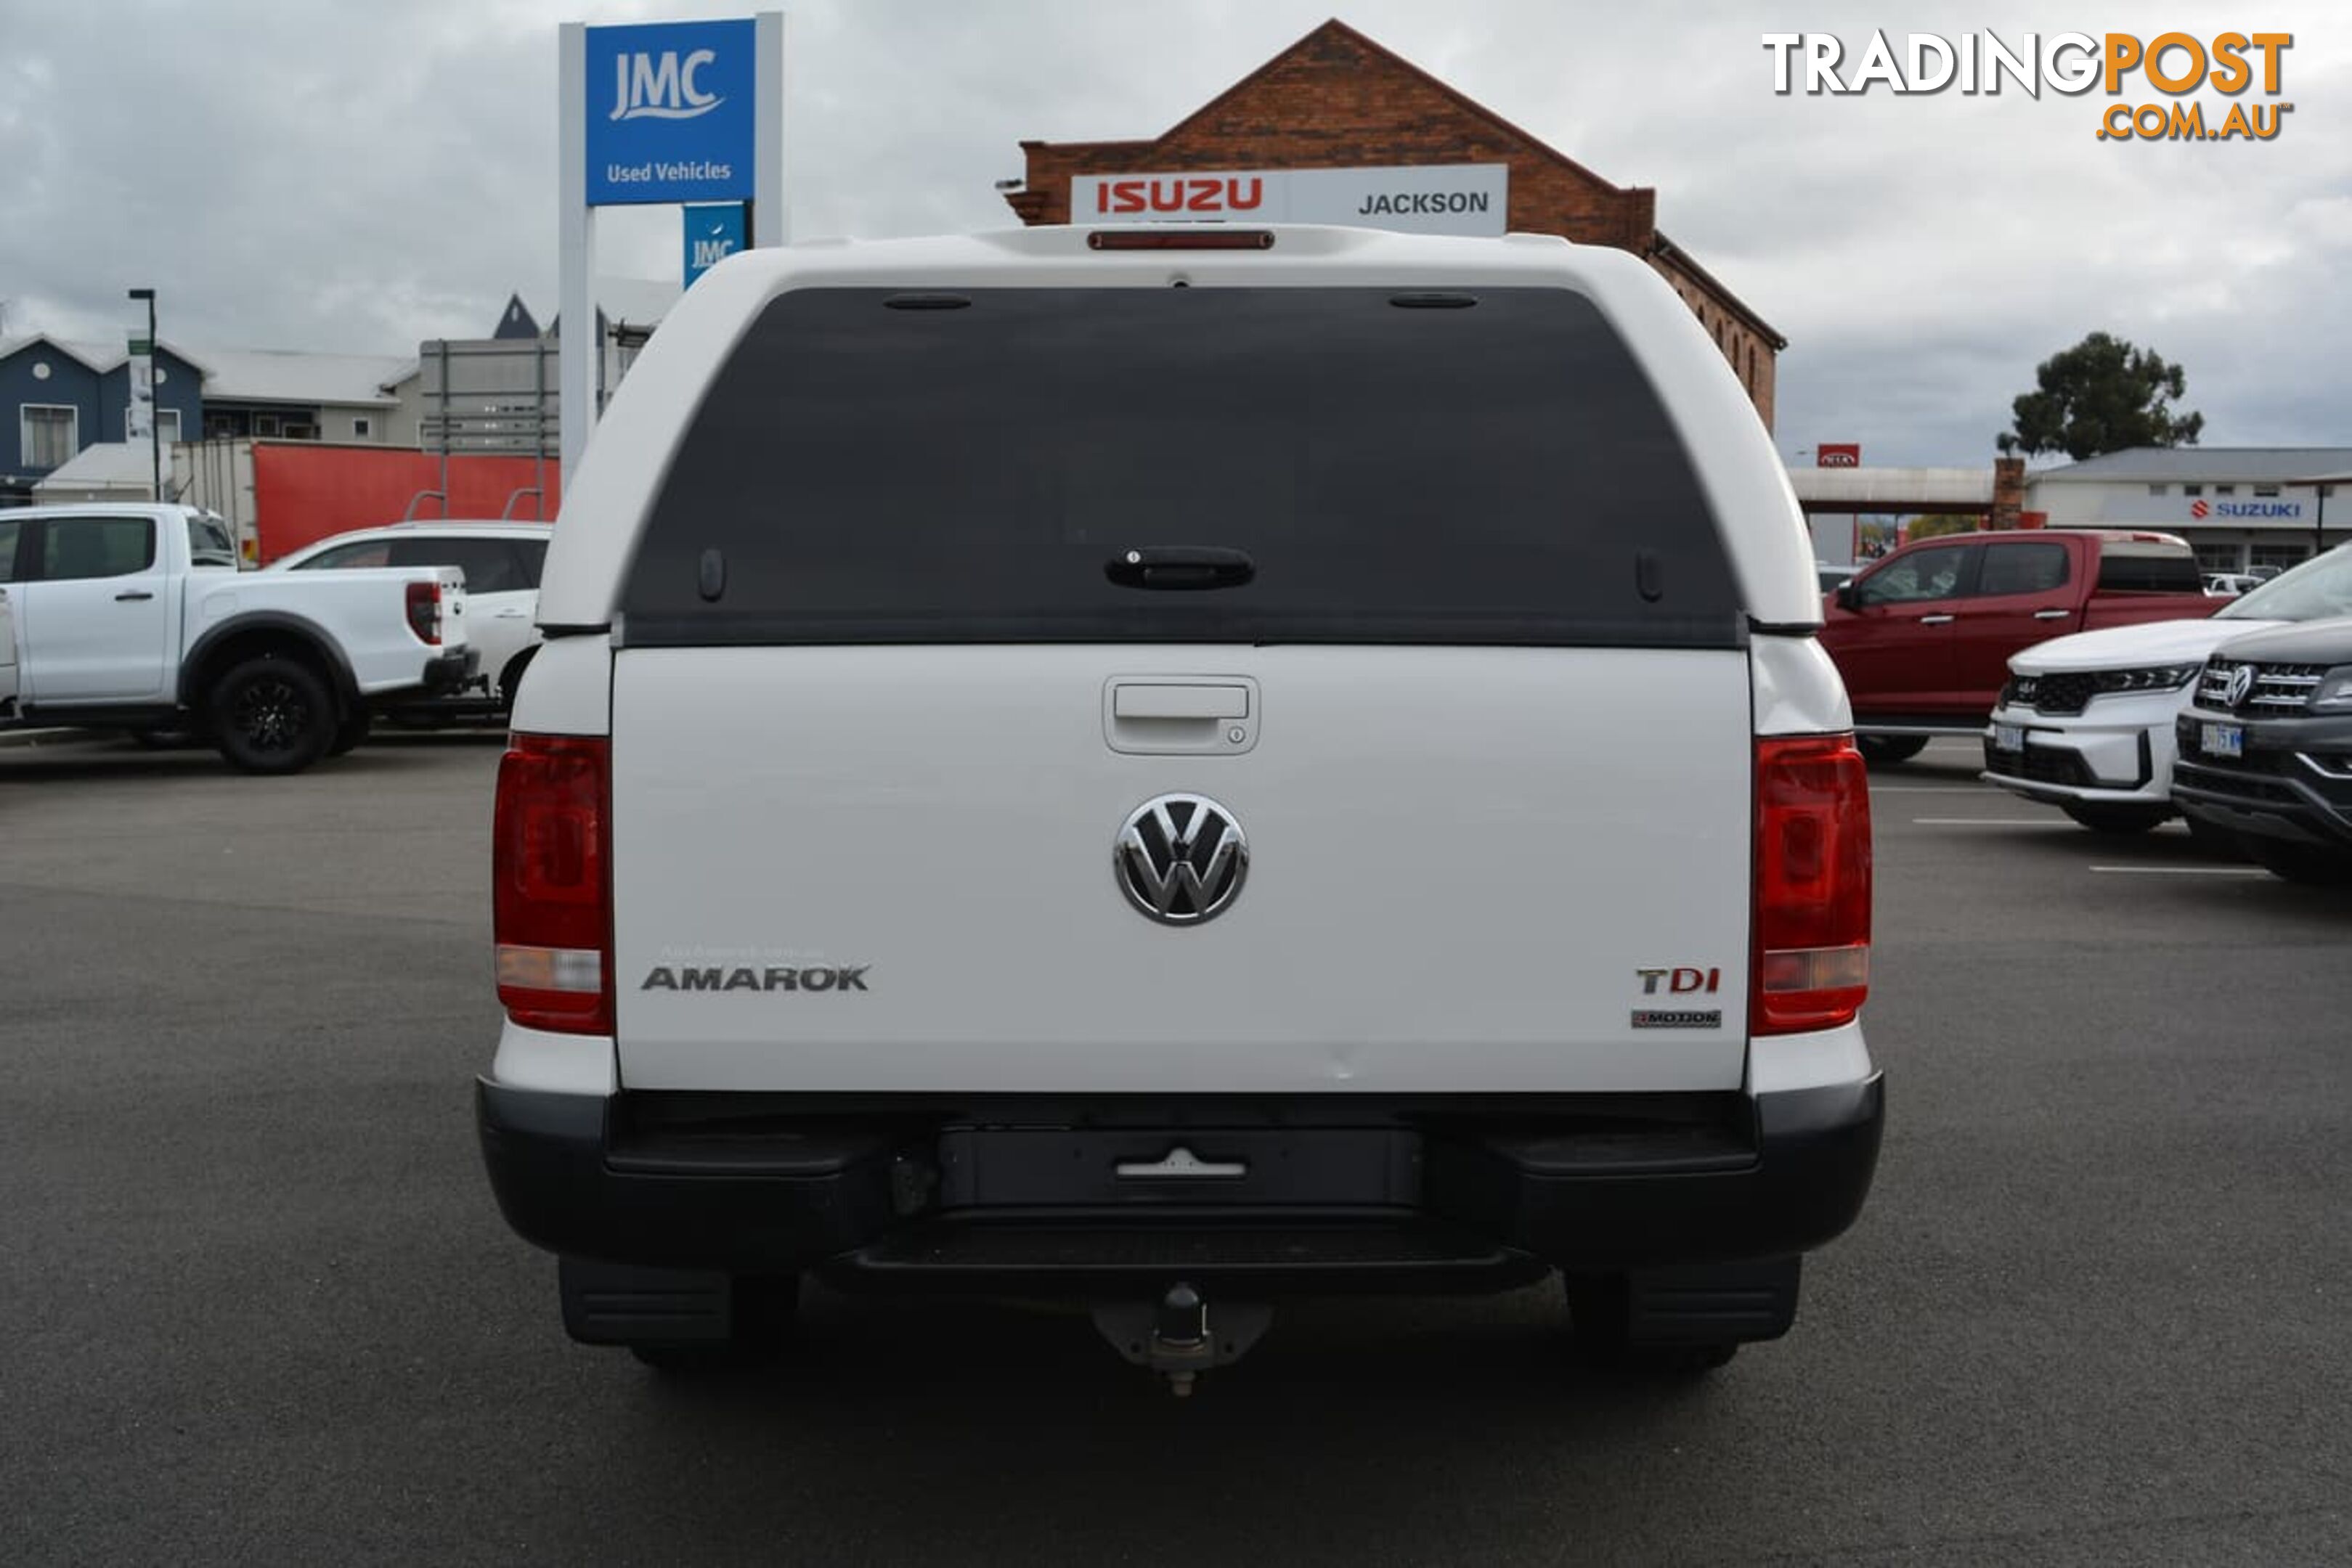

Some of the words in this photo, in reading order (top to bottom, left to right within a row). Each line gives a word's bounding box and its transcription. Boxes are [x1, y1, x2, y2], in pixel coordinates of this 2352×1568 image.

[609, 49, 726, 121] JMC
[607, 163, 651, 183] Used
[655, 161, 731, 181] Vehicles
[1097, 178, 1262, 213] ISUZU
[1359, 192, 1489, 217] JACKSON
[2216, 503, 2301, 518] SUZUKI
[640, 965, 871, 991] AMAROK
[1637, 968, 1720, 995] TDI
